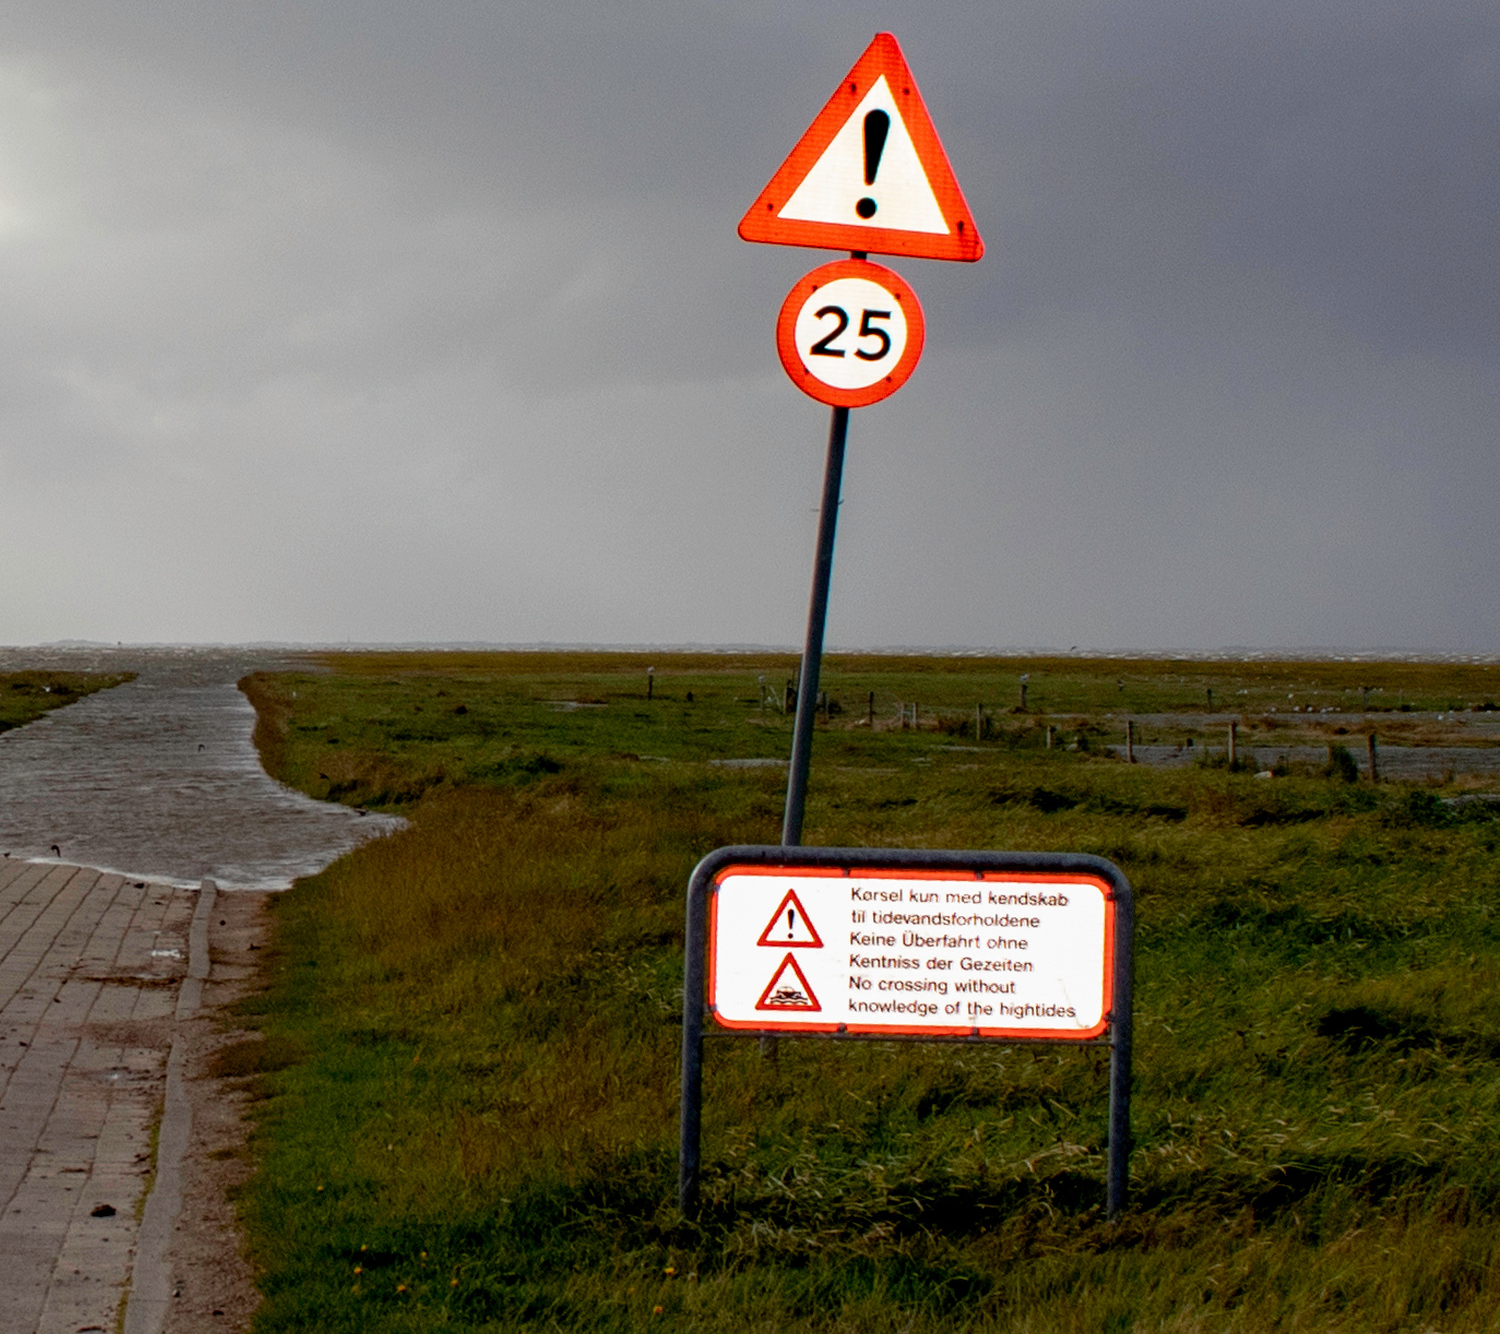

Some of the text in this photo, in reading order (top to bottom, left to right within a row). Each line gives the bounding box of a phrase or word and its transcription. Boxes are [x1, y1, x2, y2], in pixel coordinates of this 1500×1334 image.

[810, 305, 892, 361] 25
[909, 889, 938, 903] kun
[946, 890, 982, 904] med
[988, 891, 1069, 907] kendskab
[851, 909, 1040, 927] til tidevandsforholdene
[850, 929, 1028, 950] Keine Überfahrt ohne
[849, 953, 1033, 972] Kentniss der Gezeiten
[849, 976, 1016, 995] No crossing without
[849, 998, 1076, 1019] knowledge of the hightides
